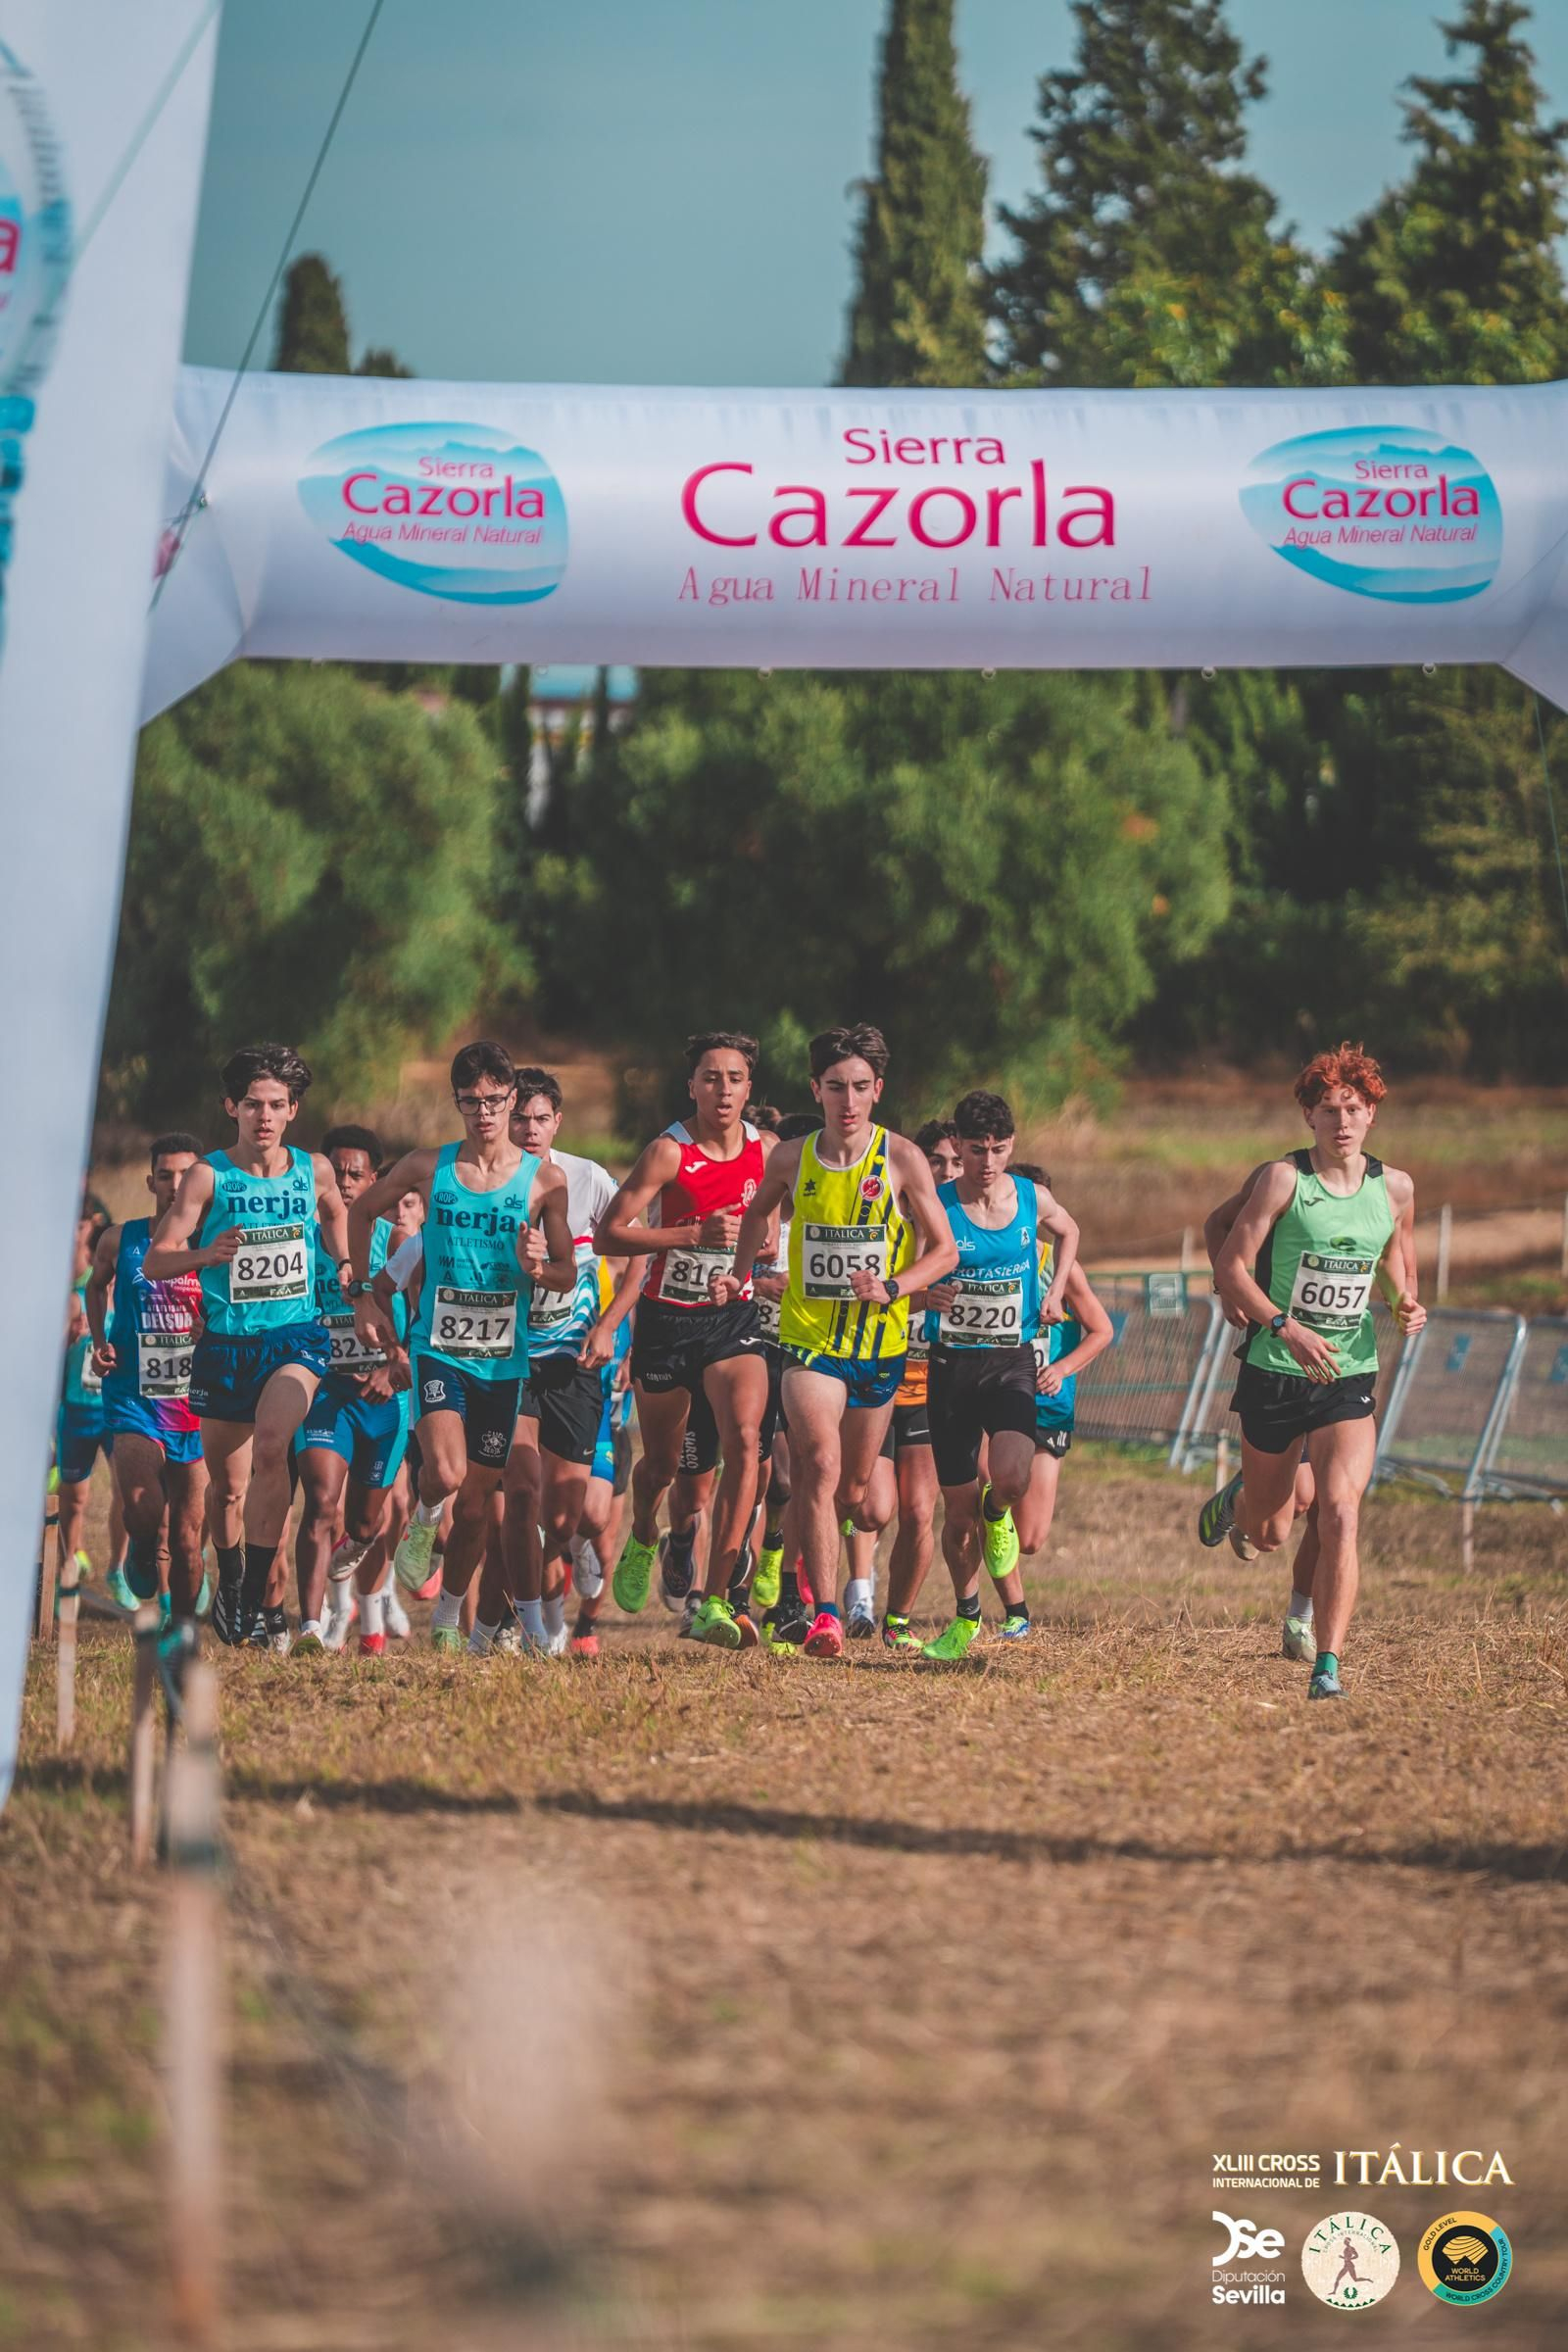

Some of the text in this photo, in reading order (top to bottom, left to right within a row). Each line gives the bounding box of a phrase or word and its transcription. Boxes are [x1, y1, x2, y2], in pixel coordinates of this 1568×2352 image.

[843, 428, 1005, 465] Sierra
[418, 457, 495, 478] Sierra
[1354, 460, 1428, 479] Sierra
[342, 473, 544, 518] Cazorla
[681, 458, 1115, 549] Cazorla
[1283, 474, 1480, 519] Cazorla
[343, 522, 543, 545] Agua Mineral Natural
[1284, 523, 1478, 547] Agua Mineral Natural
[678, 565, 1152, 606] Agua Mineral Natural
[226, 1190, 308, 1220] nerja
[436, 1206, 515, 1237] nerja
[447, 1236, 505, 1250] ATLETISMO
[237, 1251, 303, 1281] 8204
[671, 1260, 733, 1287] 816
[809, 1253, 880, 1279] 6058
[1300, 1281, 1366, 1309] 6057
[440, 1315, 511, 1341] 8217
[949, 1304, 1016, 1329] 8220
[147, 1356, 192, 1380] 818
